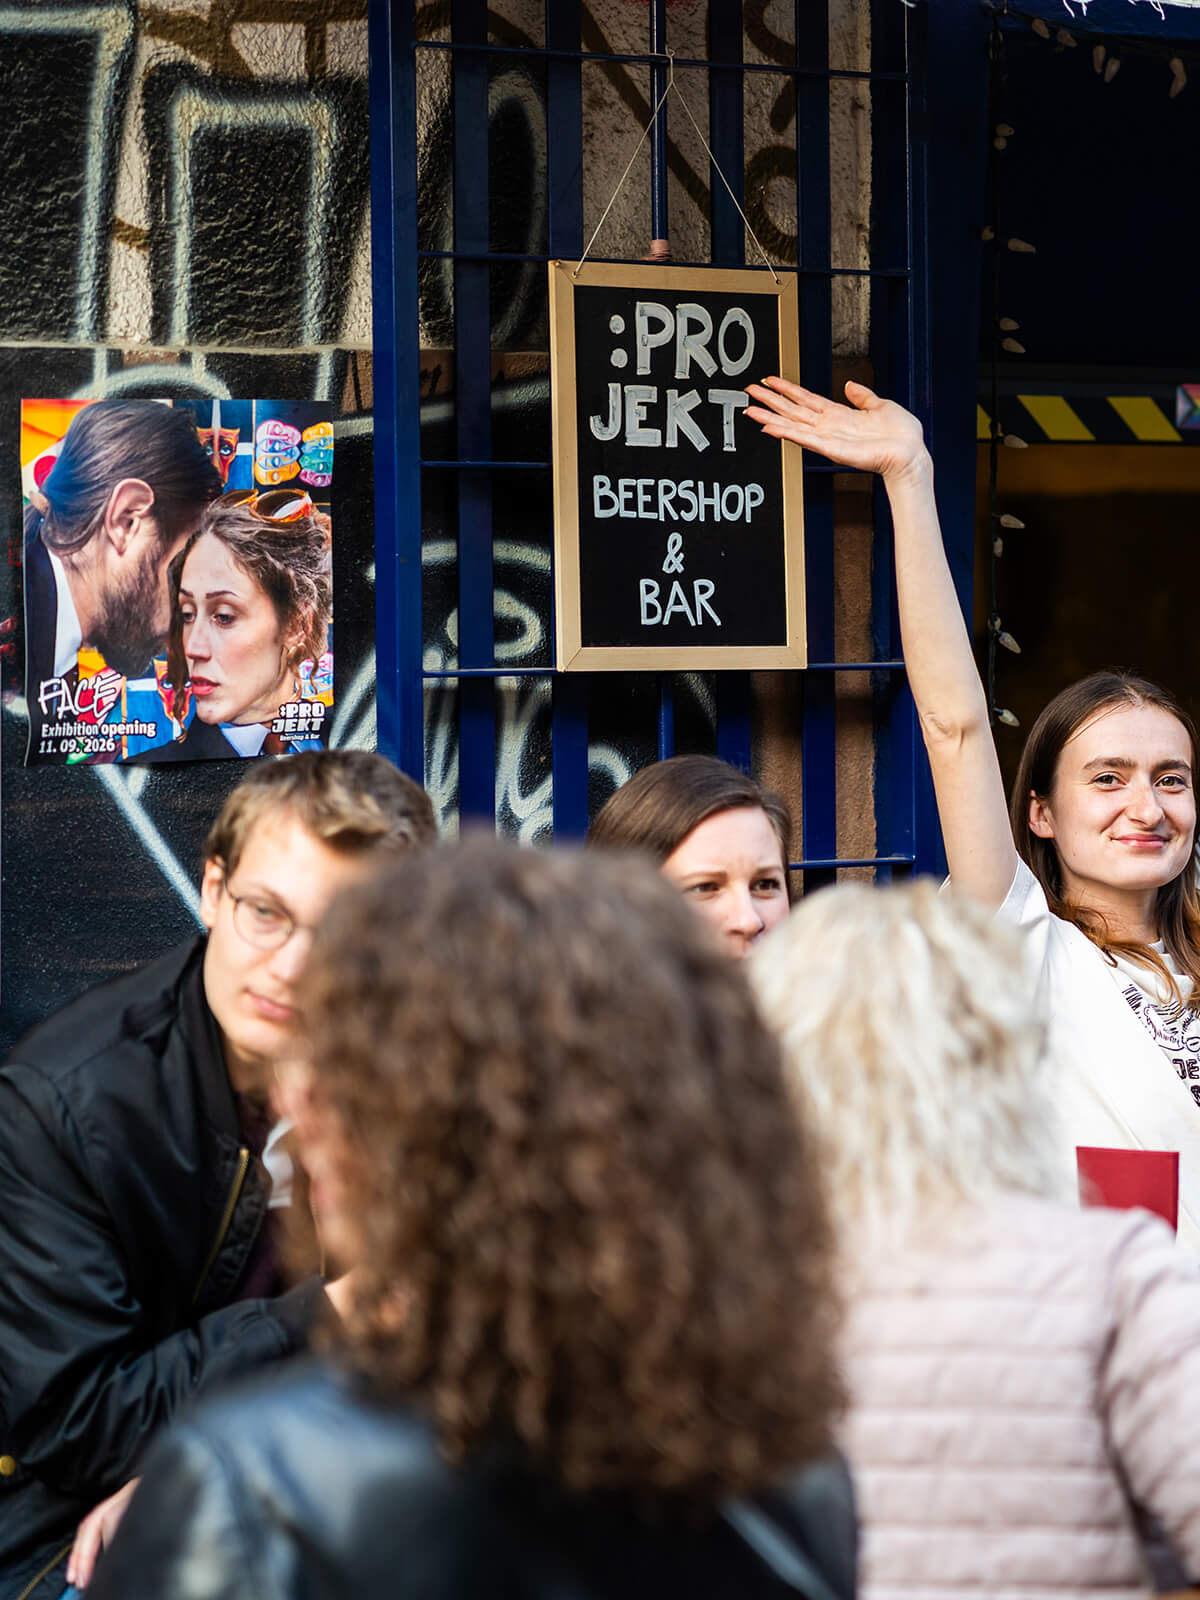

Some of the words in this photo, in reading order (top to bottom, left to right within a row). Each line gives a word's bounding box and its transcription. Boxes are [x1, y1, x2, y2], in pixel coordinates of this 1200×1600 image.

[609, 301, 756, 379] :PRO
[590, 383, 749, 452] JEKT
[593, 475, 765, 523] BEERSHOP
[662, 532, 685, 574] &
[639, 578, 722, 626] BAR
[38, 673, 122, 720] FACE
[39, 740, 57, 753] 11.
[60, 739, 80, 753] 09.
[84, 738, 115, 753] 2026
[42, 722, 99, 738] Exhibition
[101, 720, 156, 738] opening
[272, 718, 325, 733] JEKT
